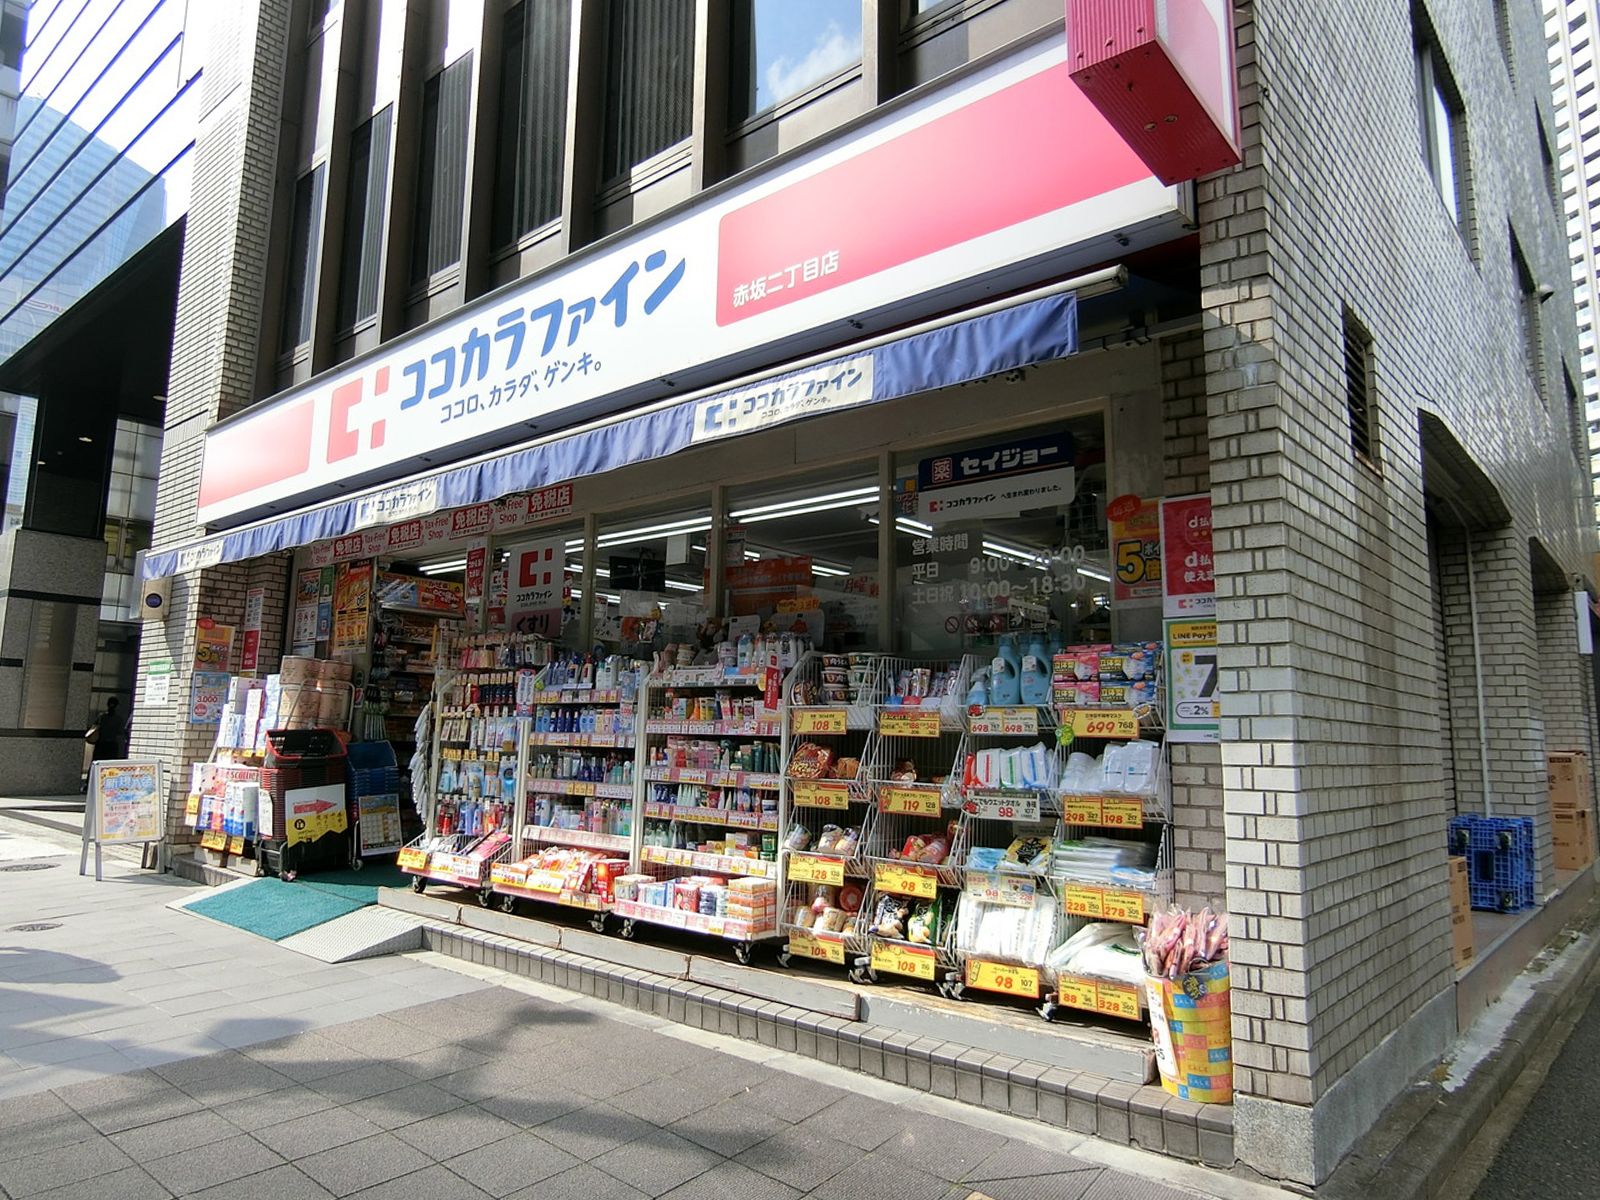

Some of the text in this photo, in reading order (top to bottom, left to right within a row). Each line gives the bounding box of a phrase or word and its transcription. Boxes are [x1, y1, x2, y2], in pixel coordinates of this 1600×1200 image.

[732, 250, 840, 308] 赤坂二丁目店
[400, 250, 686, 411] ココカラファイン
[441, 352, 602, 424] ココロ、カラダ、ゲンキ。
[743, 368, 863, 415] ココカラファイン
[934, 446, 1058, 480] 薬 セイジョー
[531, 486, 571, 512] 免税店
[946, 493, 996, 508] ココカラファイン
[455, 506, 488, 529] 免税店
[499, 513, 517, 524] Shop
[1189, 516, 1212, 528] d払
[391, 522, 420, 543] 免税店
[912, 533, 969, 556] 営業時間
[1117, 540, 1145, 585] 5
[912, 561, 939, 580] 平日
[516, 590, 553, 602] ココカラファイン
[912, 585, 954, 604] 土日祝
[1195, 597, 1216, 605] ココカ
[516, 613, 549, 635] くすり
[197, 642, 212, 662] 5
[1193, 705, 1209, 715] 2%
[812, 720, 830, 730] 108
[972, 724, 989, 732] 698
[1005, 724, 1022, 733] 698
[1087, 721, 1134, 733] 699 768
[814, 795, 831, 806] 108
[903, 800, 919, 811] 119
[998, 807, 1013, 817] 98
[1066, 813, 1085, 822] 298
[1105, 815, 1123, 824] 198
[811, 869, 827, 880] 128
[901, 880, 915, 892] 98
[985, 888, 999, 897] 98
[1019, 893, 1032, 901] 228
[1067, 902, 1086, 912] 228
[1105, 906, 1125, 917] 278
[811, 946, 826, 958] 108
[897, 960, 916, 973] 108
[995, 975, 1033, 989] 98 107
[1063, 993, 1077, 1003] 88
[1099, 999, 1120, 1012] 328
[1210, 1052, 1229, 1061] SALE
[1189, 1078, 1210, 1087] SALE
